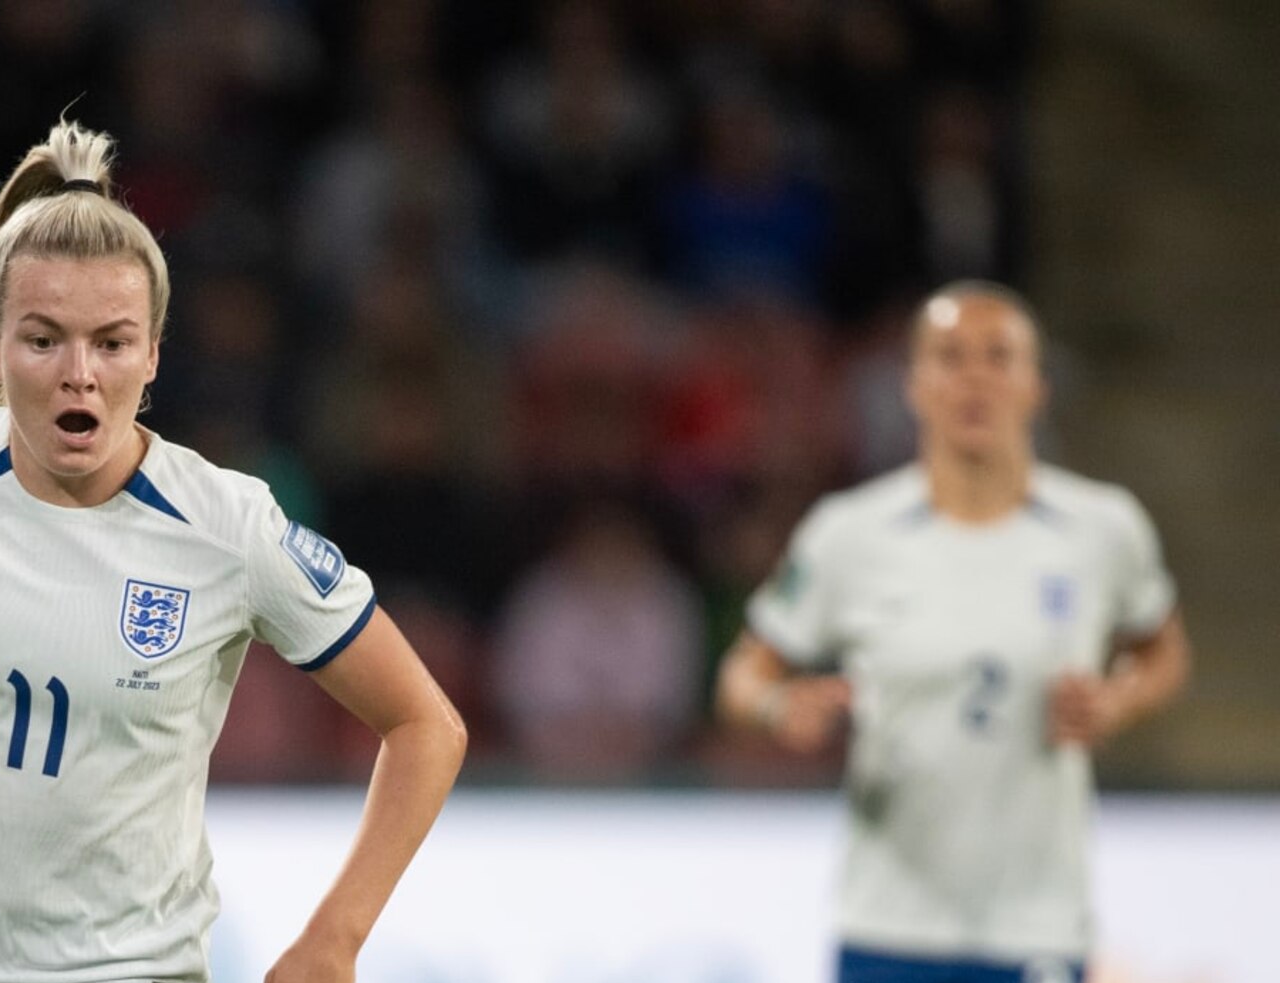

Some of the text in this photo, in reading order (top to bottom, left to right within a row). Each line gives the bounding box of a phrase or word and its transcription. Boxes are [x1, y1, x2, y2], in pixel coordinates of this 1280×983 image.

[115, 678, 126, 688] 22
[127, 679, 142, 690] JULY
[6, 668, 69, 778] 11
